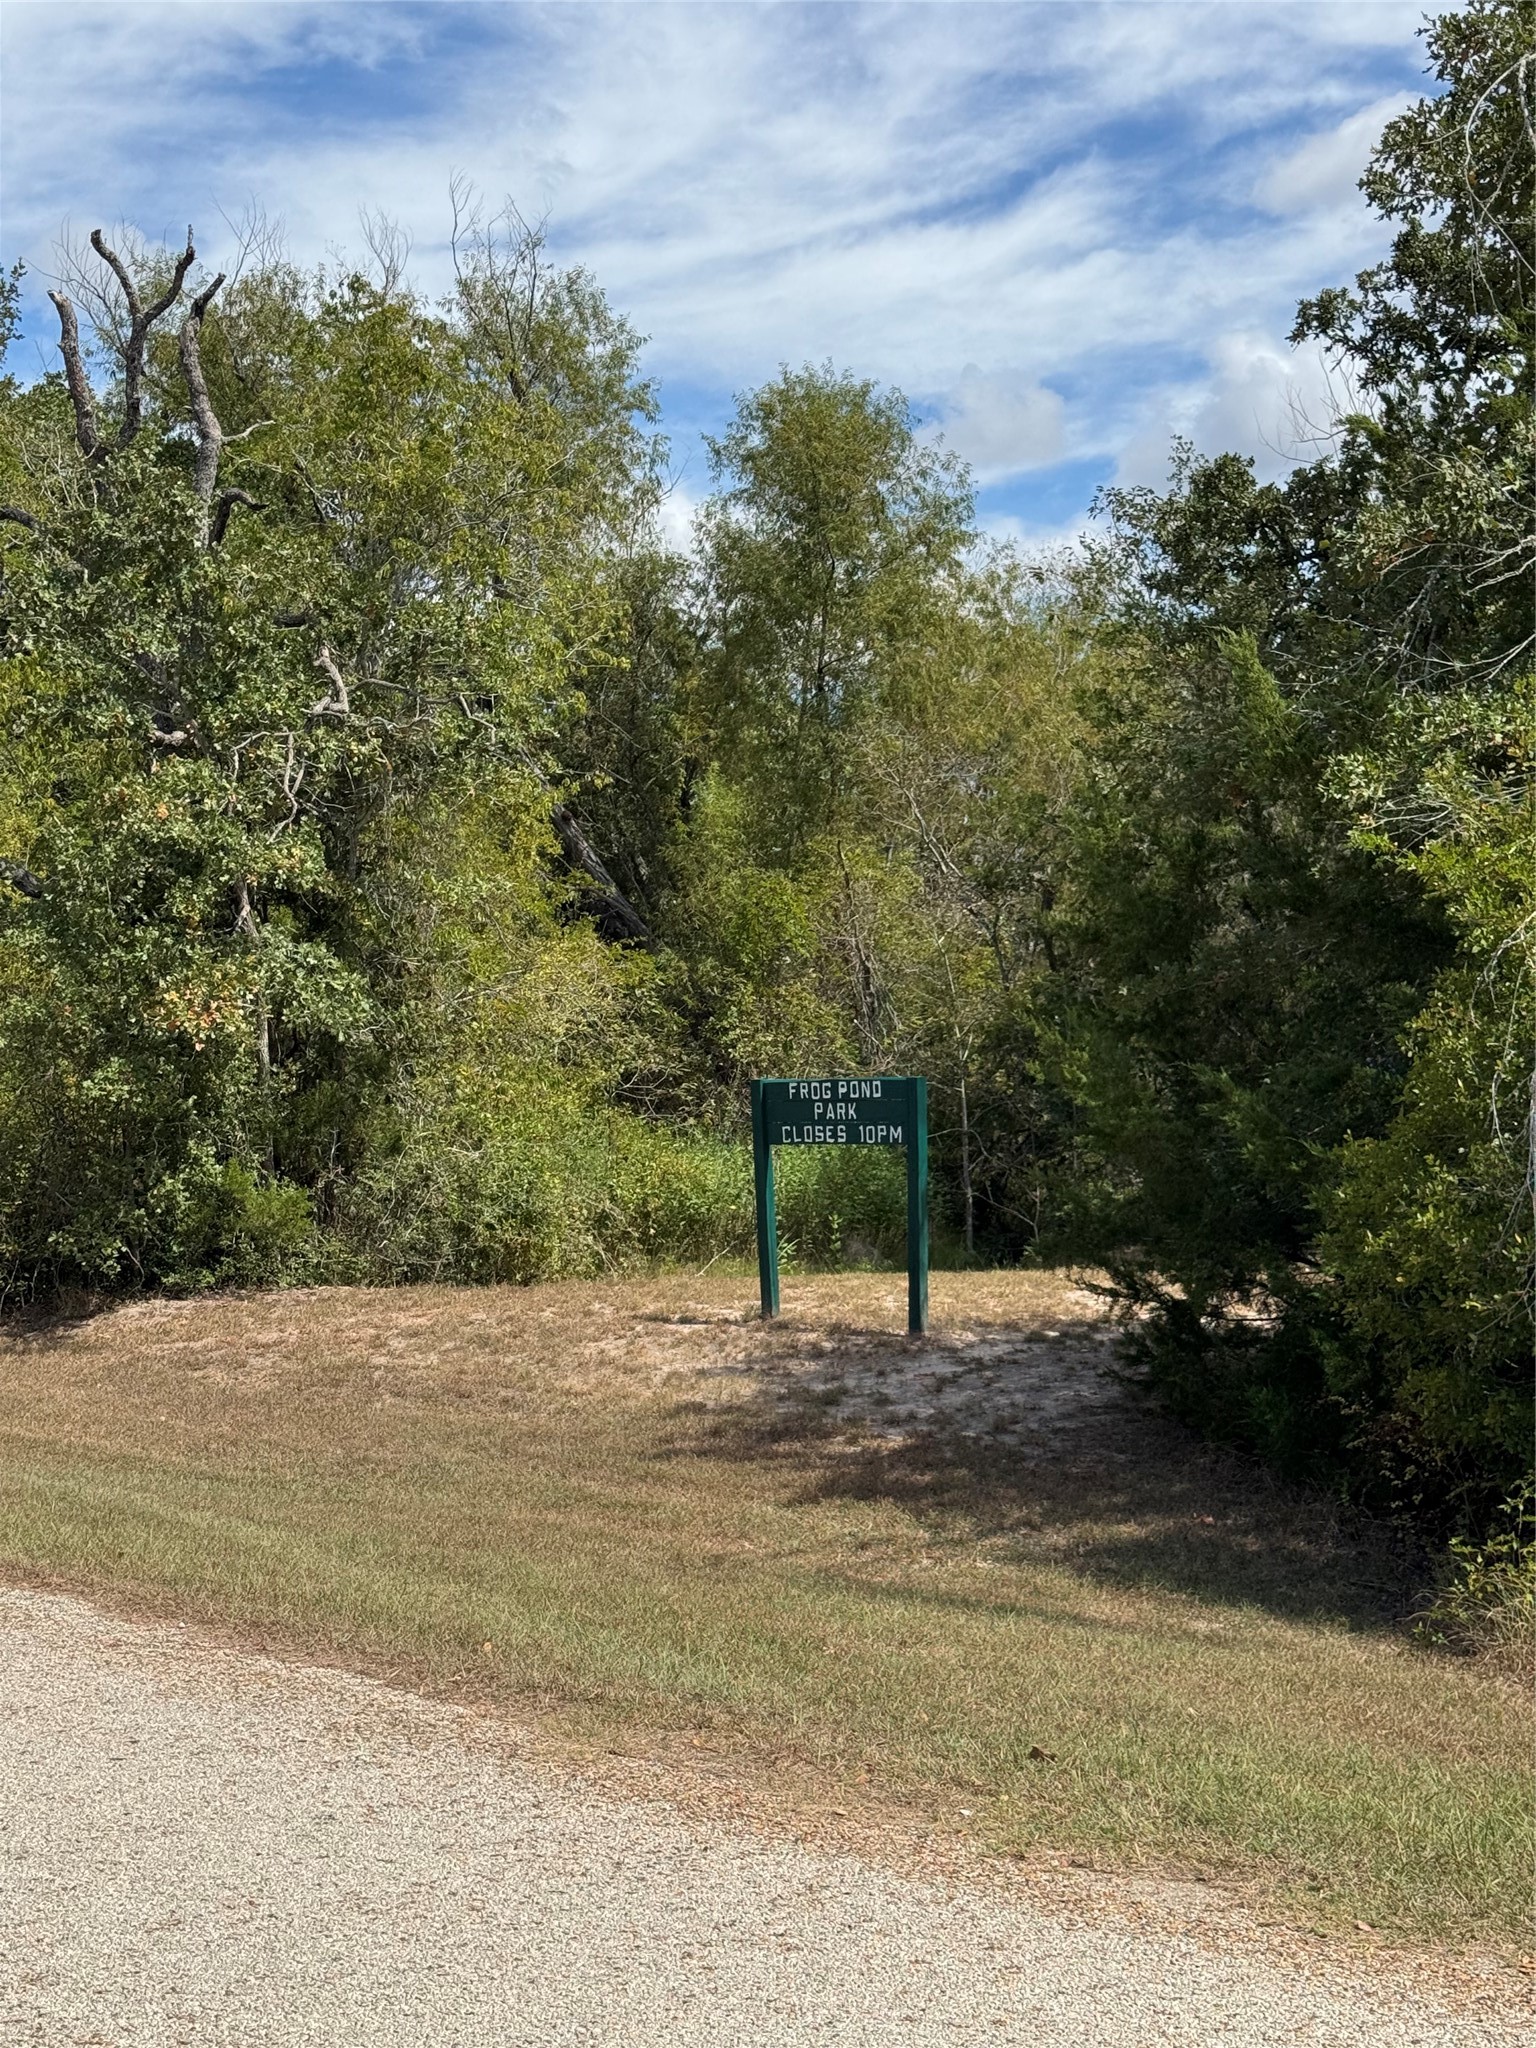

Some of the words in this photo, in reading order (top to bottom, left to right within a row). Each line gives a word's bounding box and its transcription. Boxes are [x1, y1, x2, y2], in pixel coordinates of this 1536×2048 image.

[788, 1082, 832, 1100] FROG
[838, 1080, 882, 1099] POND
[813, 1102, 858, 1120] PARK
[781, 1125, 847, 1143] CLOSES
[858, 1125, 903, 1143] 10PM
